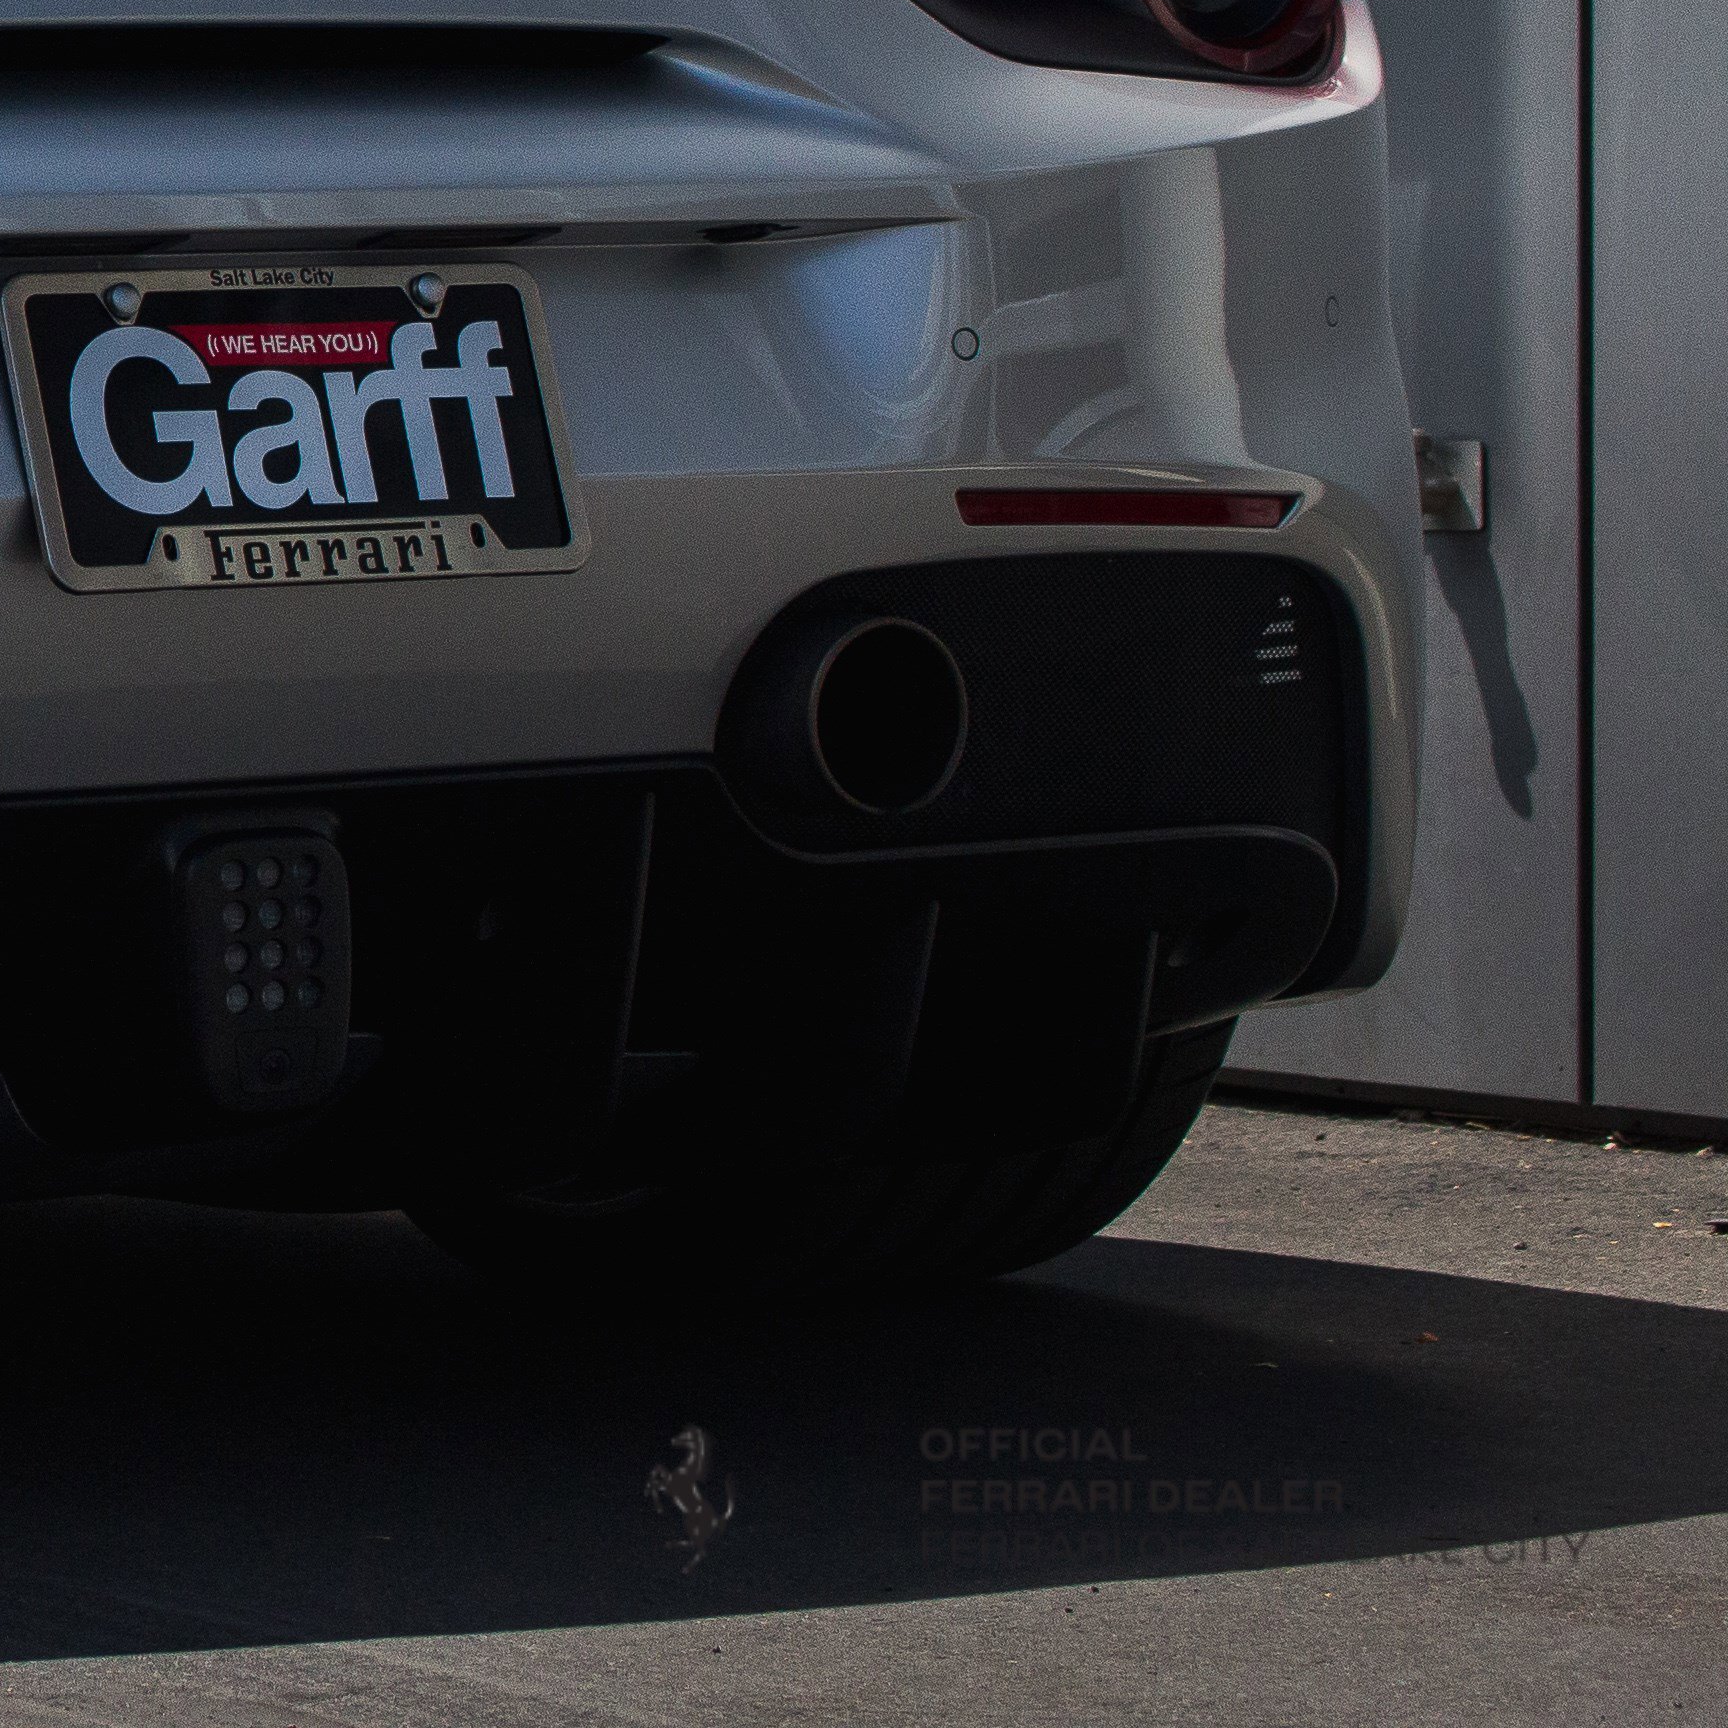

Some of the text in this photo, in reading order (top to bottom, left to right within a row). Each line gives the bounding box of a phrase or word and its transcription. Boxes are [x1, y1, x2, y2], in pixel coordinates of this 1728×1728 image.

[209, 267, 335, 287] Salt Lake City
[221, 332, 363, 354] WE HEAR YOU
[70, 320, 517, 515] Garff
[203, 520, 453, 581] Ferrari
